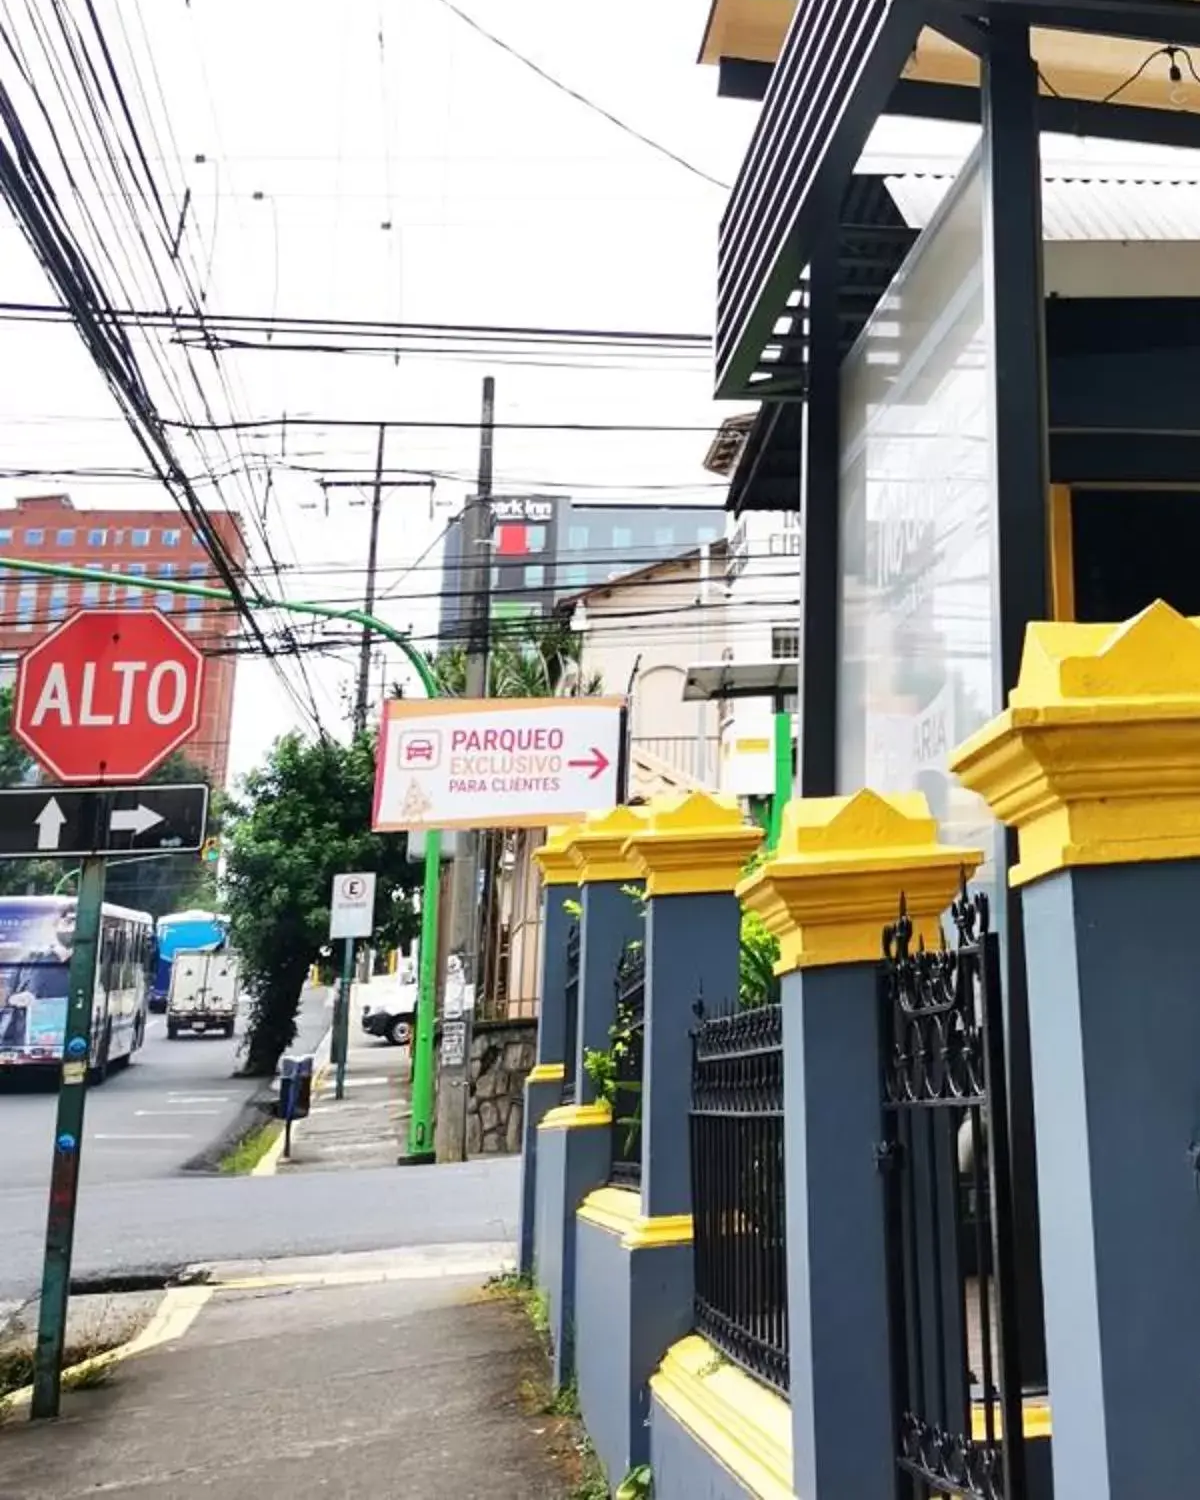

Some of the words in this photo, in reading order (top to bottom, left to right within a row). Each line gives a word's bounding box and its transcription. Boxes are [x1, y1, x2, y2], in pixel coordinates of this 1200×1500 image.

[31, 660, 187, 726] ALTO
[451, 728, 565, 752] PARQUEO
[449, 754, 562, 776] EXCLUSIVO
[448, 779, 488, 793] PARA
[491, 777, 561, 792] CLIENTES
